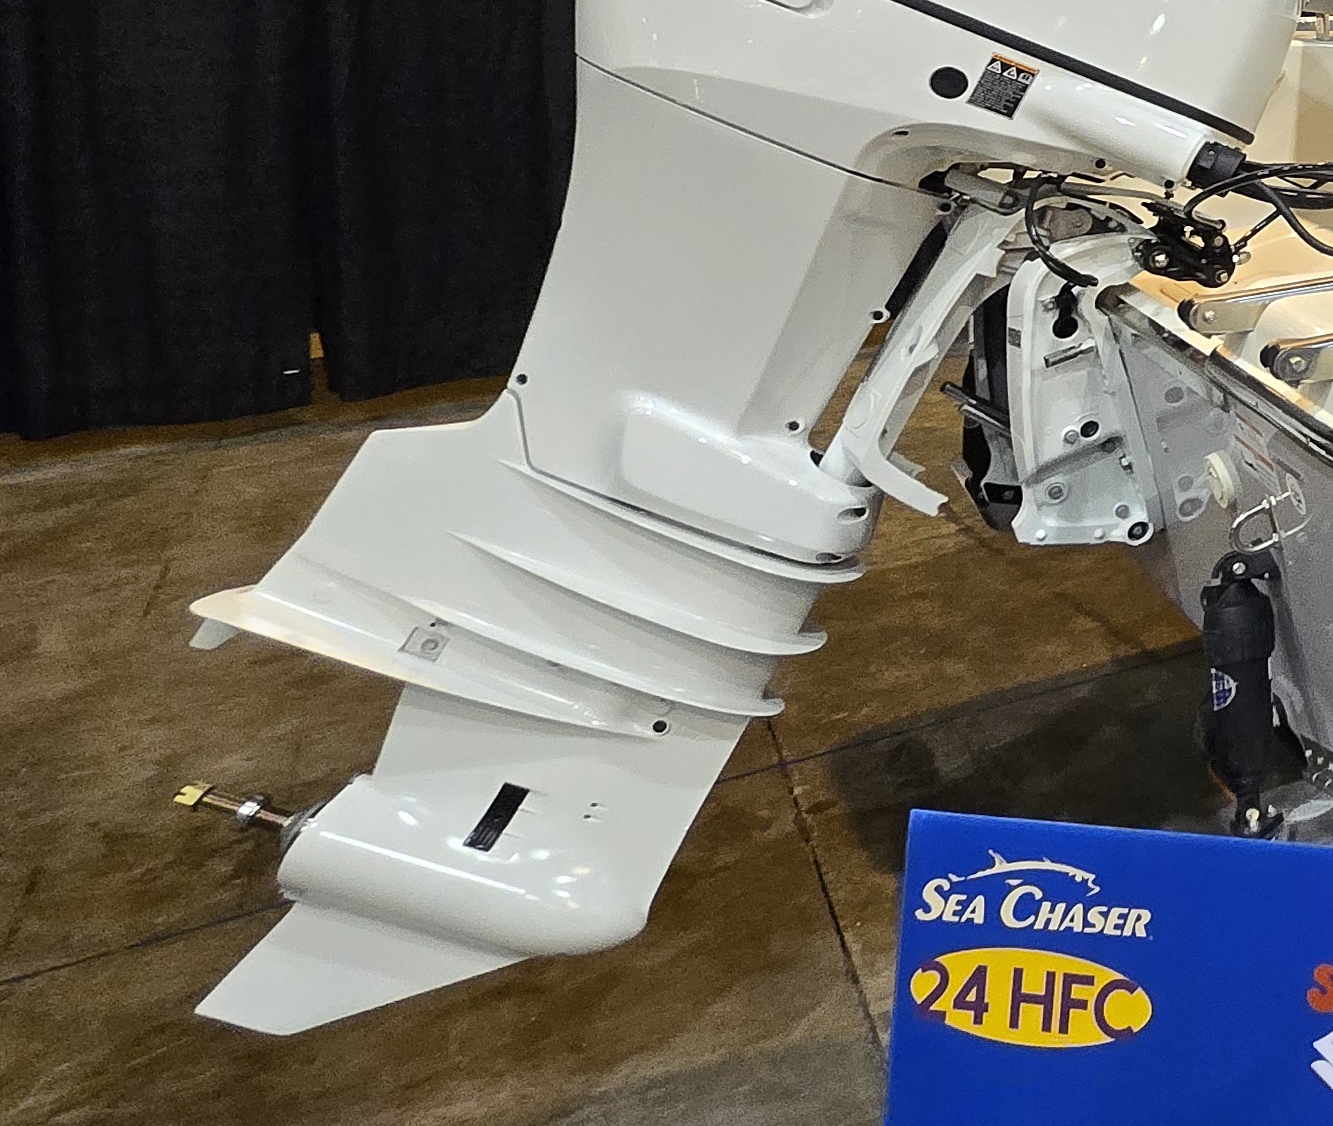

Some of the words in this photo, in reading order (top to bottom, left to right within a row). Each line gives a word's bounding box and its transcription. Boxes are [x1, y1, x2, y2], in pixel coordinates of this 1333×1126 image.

[914, 878, 986, 924] SEA
[999, 884, 1152, 937] CHASER
[914, 959, 990, 1026] 24
[1008, 966, 1140, 1041] HFC
